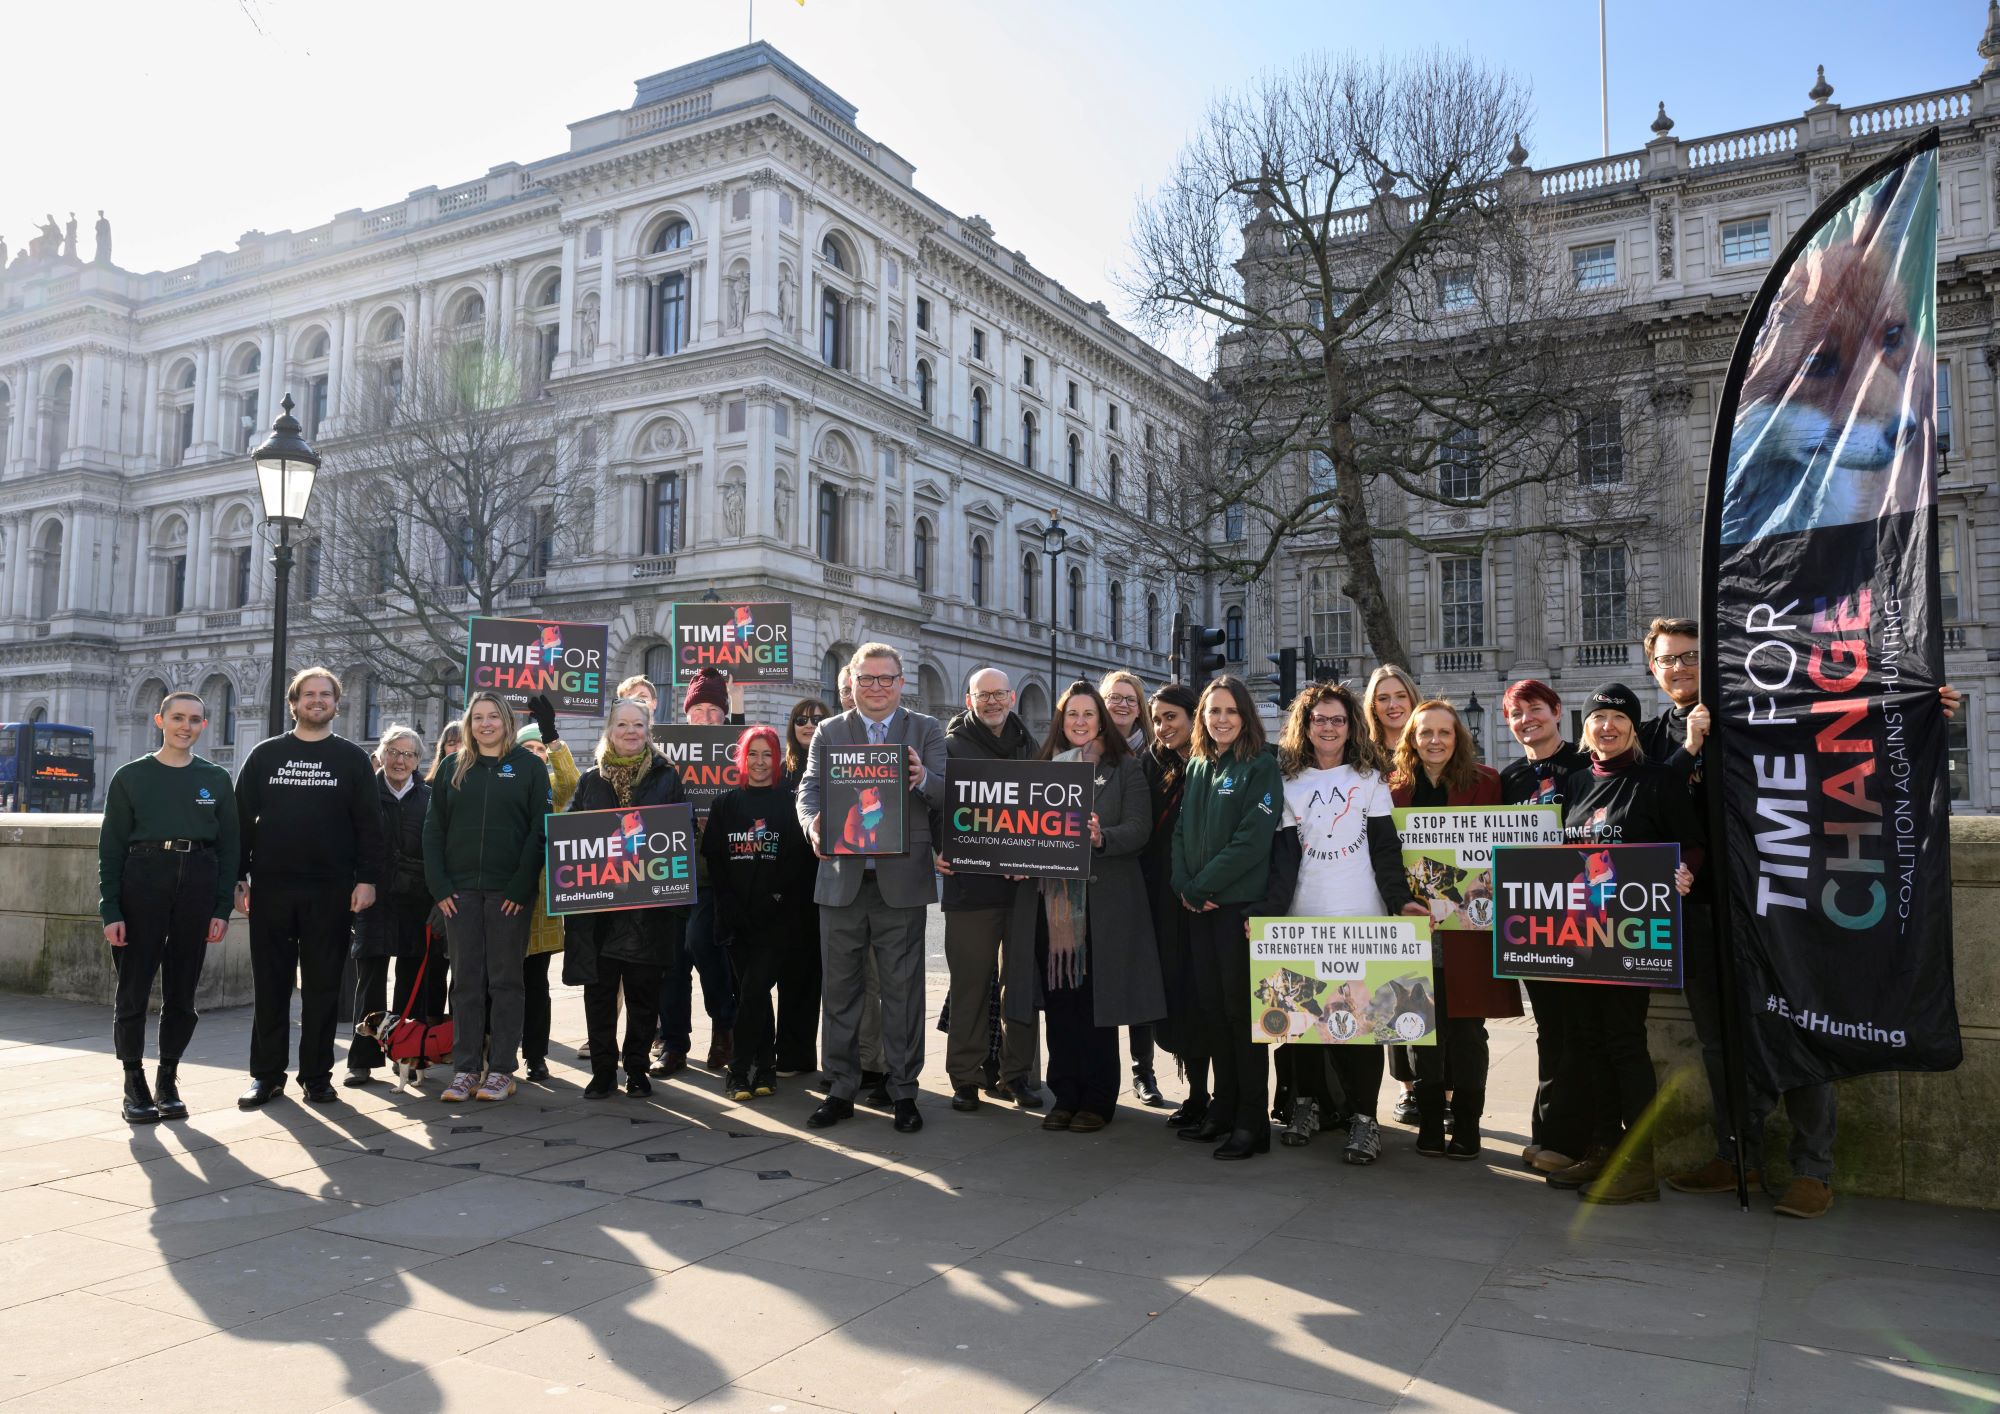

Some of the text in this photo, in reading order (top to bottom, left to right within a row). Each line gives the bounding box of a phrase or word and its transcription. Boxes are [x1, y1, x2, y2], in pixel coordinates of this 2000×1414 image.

[679, 624, 788, 643] TIME FOR
[475, 642, 600, 669] TIME FOR
[680, 644, 789, 665] CHANGE
[473, 665, 600, 694] CHANGE
[572, 697, 599, 705] LEAGUE
[712, 743, 741, 762] FO
[1882, 700, 1911, 793] AGAINST
[285, 759, 323, 769] Animal
[830, 752, 899, 765] TIME FOR
[1744, 598, 1811, 917] TIME FOR
[1807, 588, 1887, 930] CHANGE
[277, 767, 331, 778] Defenders
[830, 765, 899, 779] CHANGE
[268, 776, 338, 787] International
[954, 780, 1083, 808] TIME FOR
[1543, 793, 1565, 805] FO
[953, 806, 1081, 837] CHANGE
[1413, 814, 1539, 829] STOP THE KILLING
[728, 831, 780, 843] TIME FOR
[1399, 830, 1563, 844] STRENGTHEN THE HUNTING ACT
[1594, 824, 1623, 838] FOR
[553, 831, 687, 861] TIME FOR
[729, 841, 779, 853] CHANGE
[1000, 838, 1036, 847] AGAINST
[555, 855, 689, 889] CHANGE
[952, 858, 1080, 872] #EndHunting www.timeforchangecoalition.co.uk
[555, 883, 690, 903] #EndHunting LEAGUE
[1502, 882, 1671, 912] TIME FOR
[1272, 926, 1398, 940] STOP THE KILLING
[1503, 914, 1673, 950] CHANGE
[1257, 943, 1422, 955] STRENGTHEN THE HUNTING ACT
[1321, 961, 1360, 974] NOW
[1503, 952, 1673, 968] #EndHunting LEAGUE
